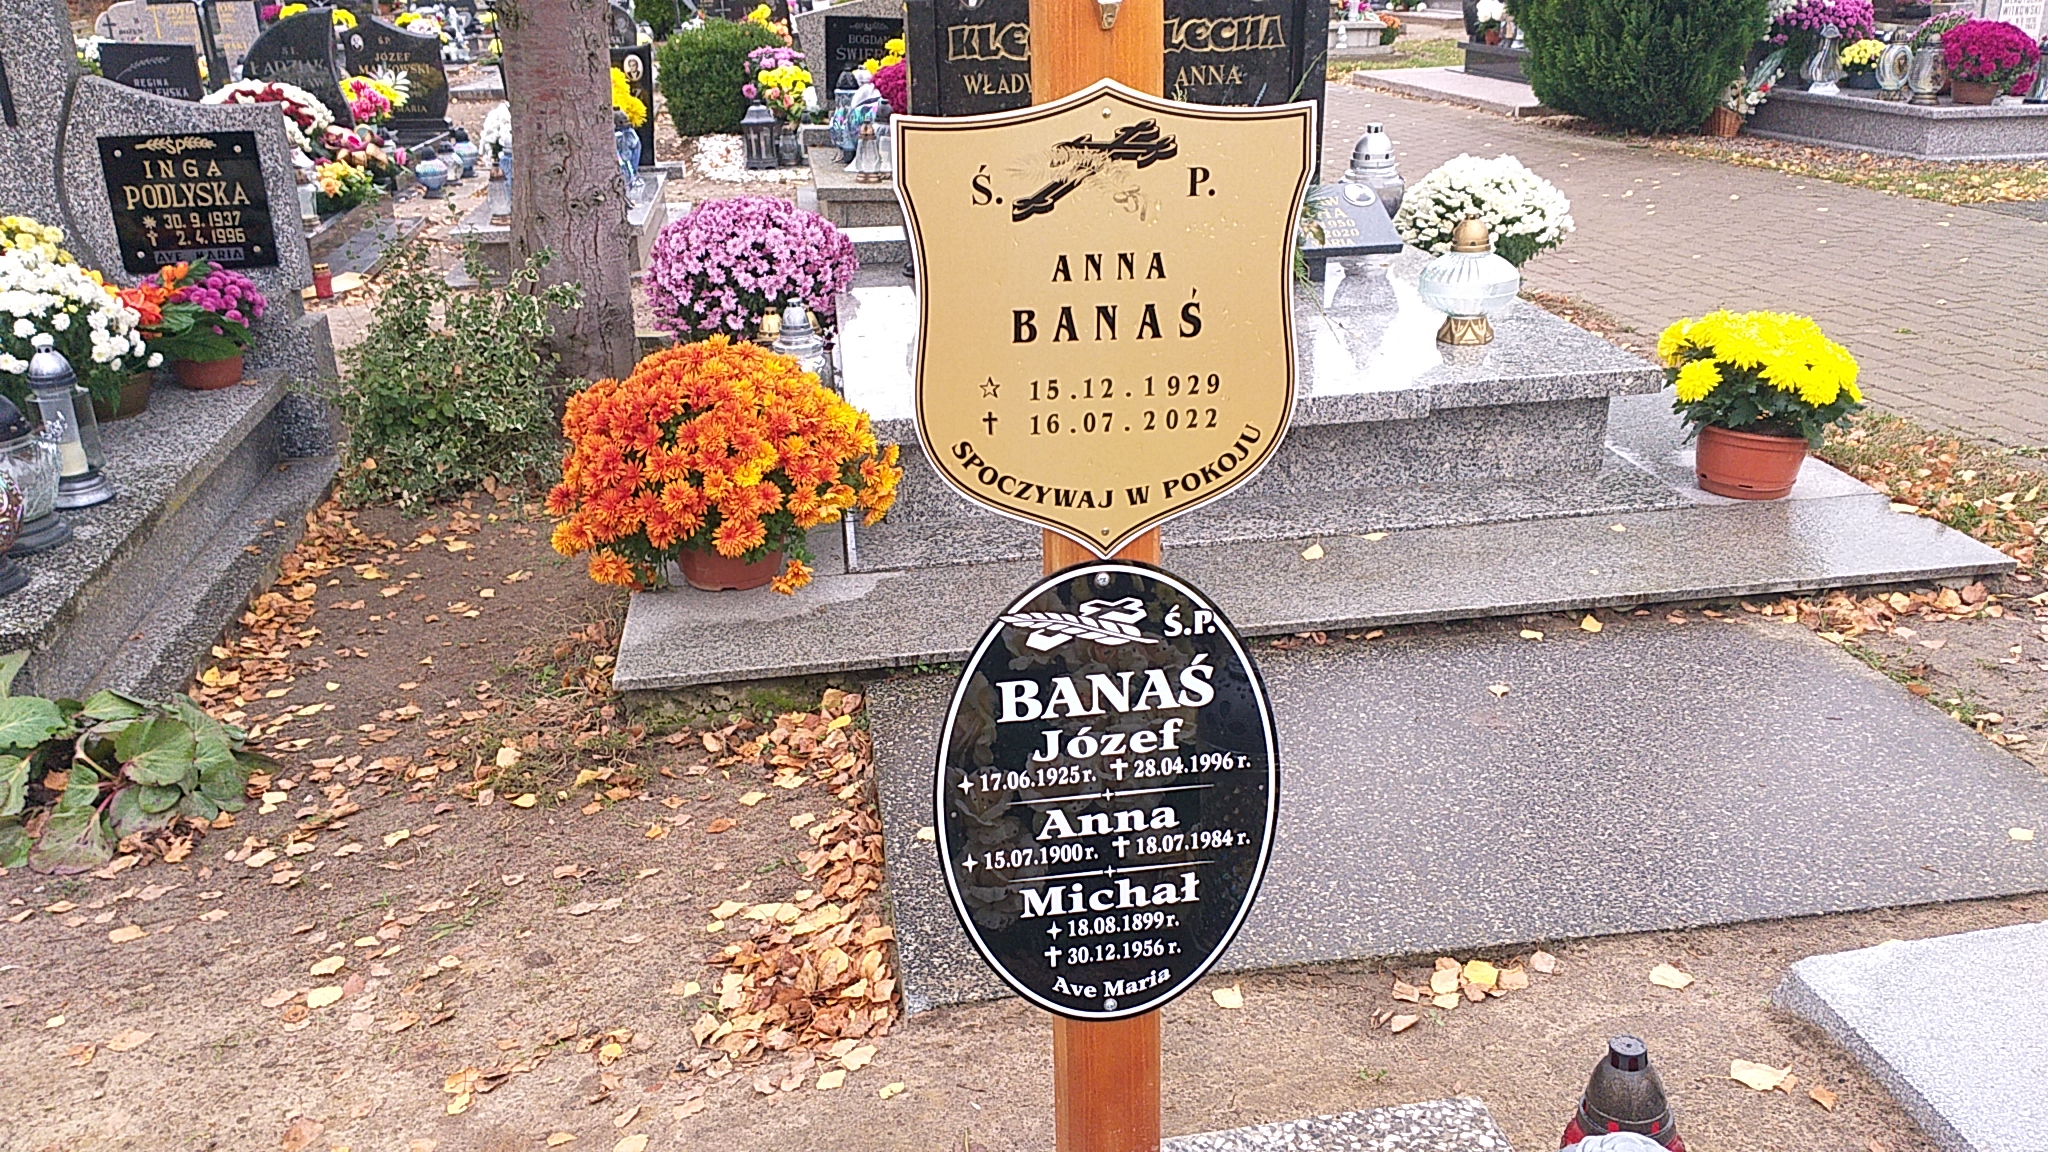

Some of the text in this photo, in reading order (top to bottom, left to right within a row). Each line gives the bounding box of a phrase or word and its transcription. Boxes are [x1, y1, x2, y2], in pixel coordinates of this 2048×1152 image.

[947, 22, 1032, 62] KLE
[1164, 14, 1286, 53] LECHA
[375, 51, 411, 62] JÓZEF
[133, 78, 169, 88] REGINA
[963, 73, 1033, 95] WŁADY
[1173, 63, 1244, 87] ANNA
[143, 158, 223, 179] INGA
[970, 164, 1217, 206] Ś. P.
[122, 181, 251, 211] PODLYSKA
[156, 248, 244, 264] AVE MARIA
[1051, 252, 1167, 282] ANNA
[1012, 288, 1203, 344] BANAŚ
[1029, 373, 1221, 402] 15.12.1929
[1029, 407, 1219, 436] 16.07.2022
[951, 423, 1263, 510] SPOCZYWAJ W POKOJU
[1163, 603, 1217, 638] Ś.P.
[995, 653, 1216, 724] BANAŚ
[1031, 718, 1184, 763] Józef
[1035, 804, 1181, 842] Anna
[1019, 872, 1201, 919] Michał
[1052, 966, 1172, 999] Ave Maria
